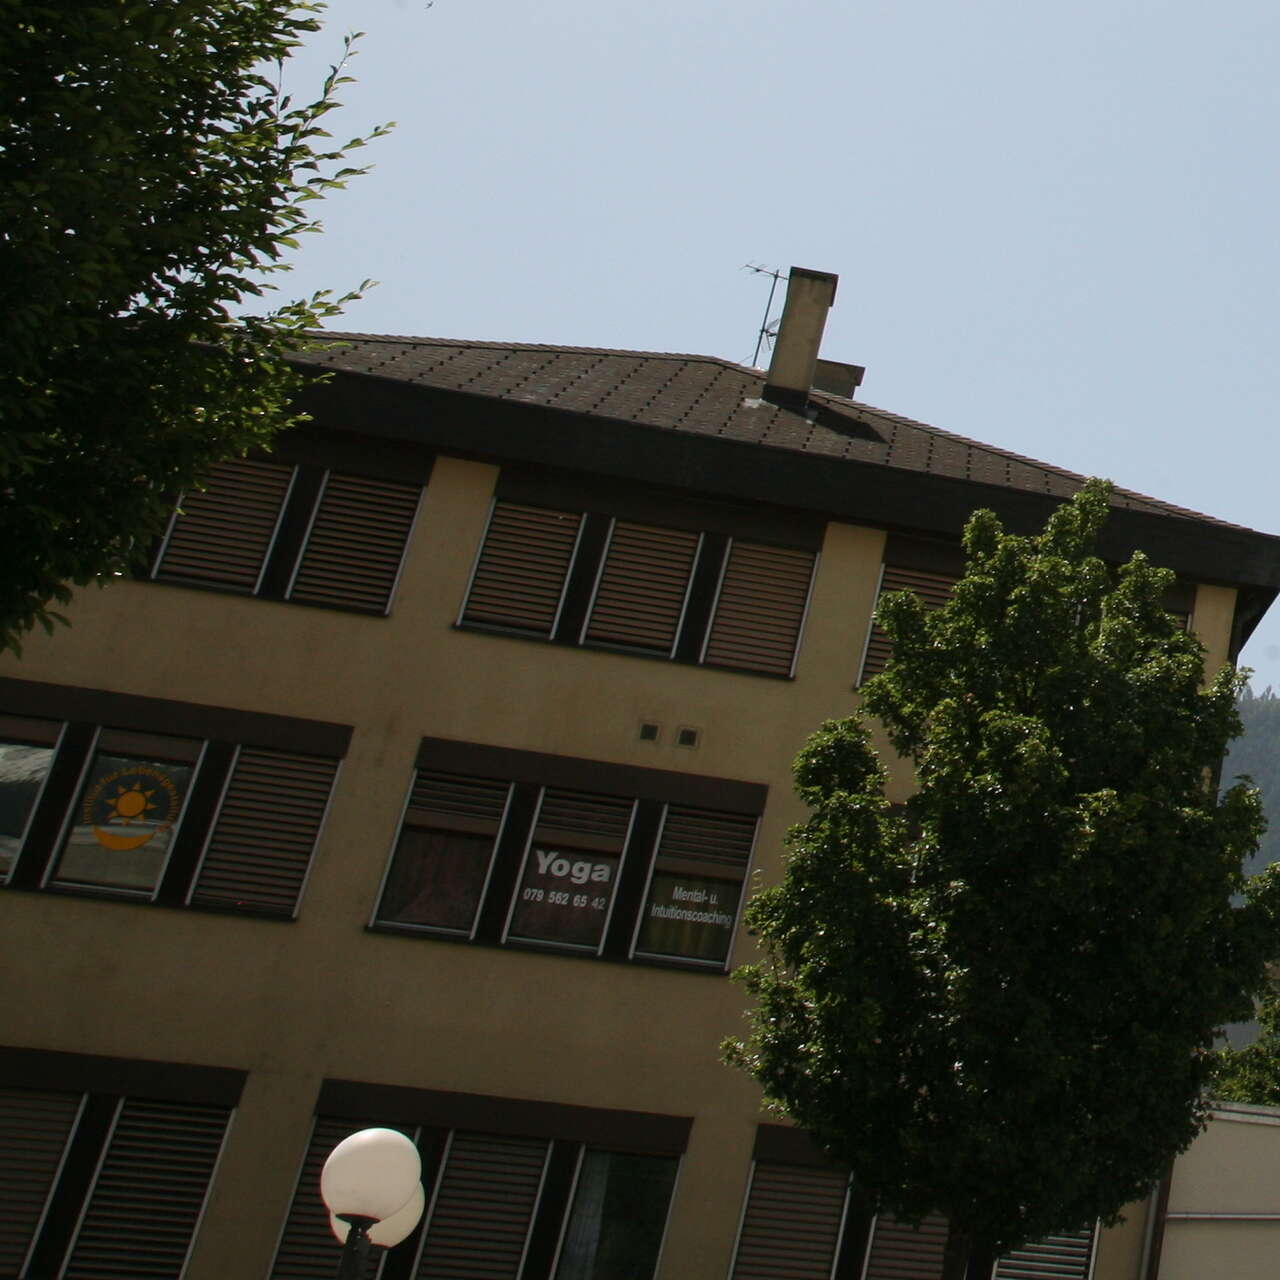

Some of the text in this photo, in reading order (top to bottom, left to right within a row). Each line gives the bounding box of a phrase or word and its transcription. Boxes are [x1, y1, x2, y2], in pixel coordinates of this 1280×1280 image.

[536, 850, 611, 885] Yoga
[523, 887, 607, 911] 079 562 65 42
[672, 885, 719, 905] Mental- u.
[650, 903, 733, 928] Intuitionscoaching
